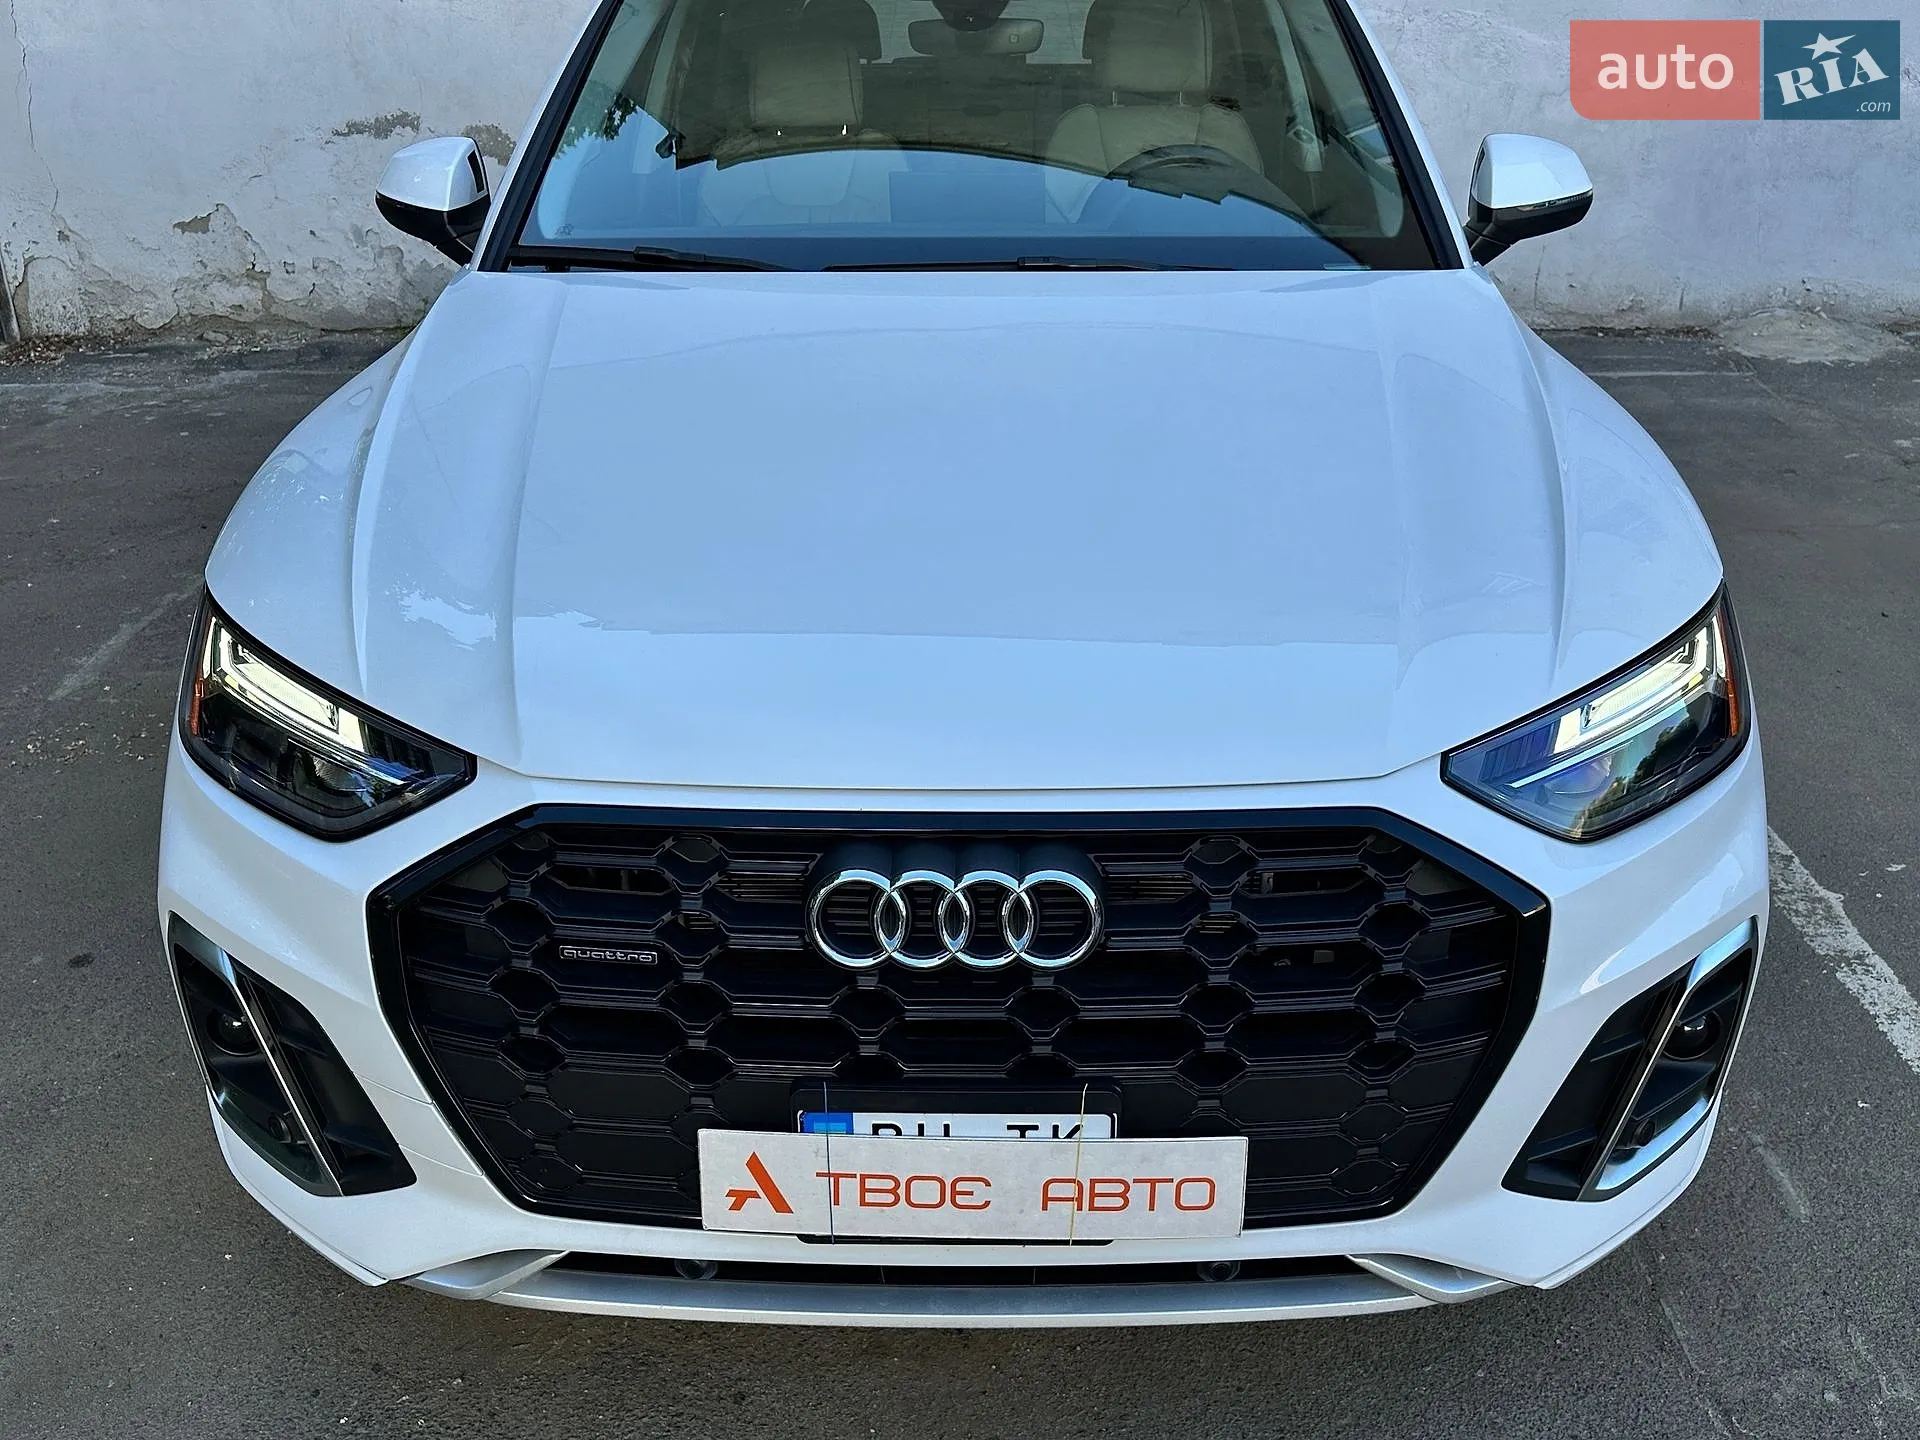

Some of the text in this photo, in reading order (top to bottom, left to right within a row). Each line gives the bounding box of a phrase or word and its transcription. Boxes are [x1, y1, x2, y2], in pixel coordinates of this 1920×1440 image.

[563, 949, 653, 962] quattro
[815, 1171, 992, 1211] ТВОЄ
[1041, 1175, 1216, 1213] АВТО
